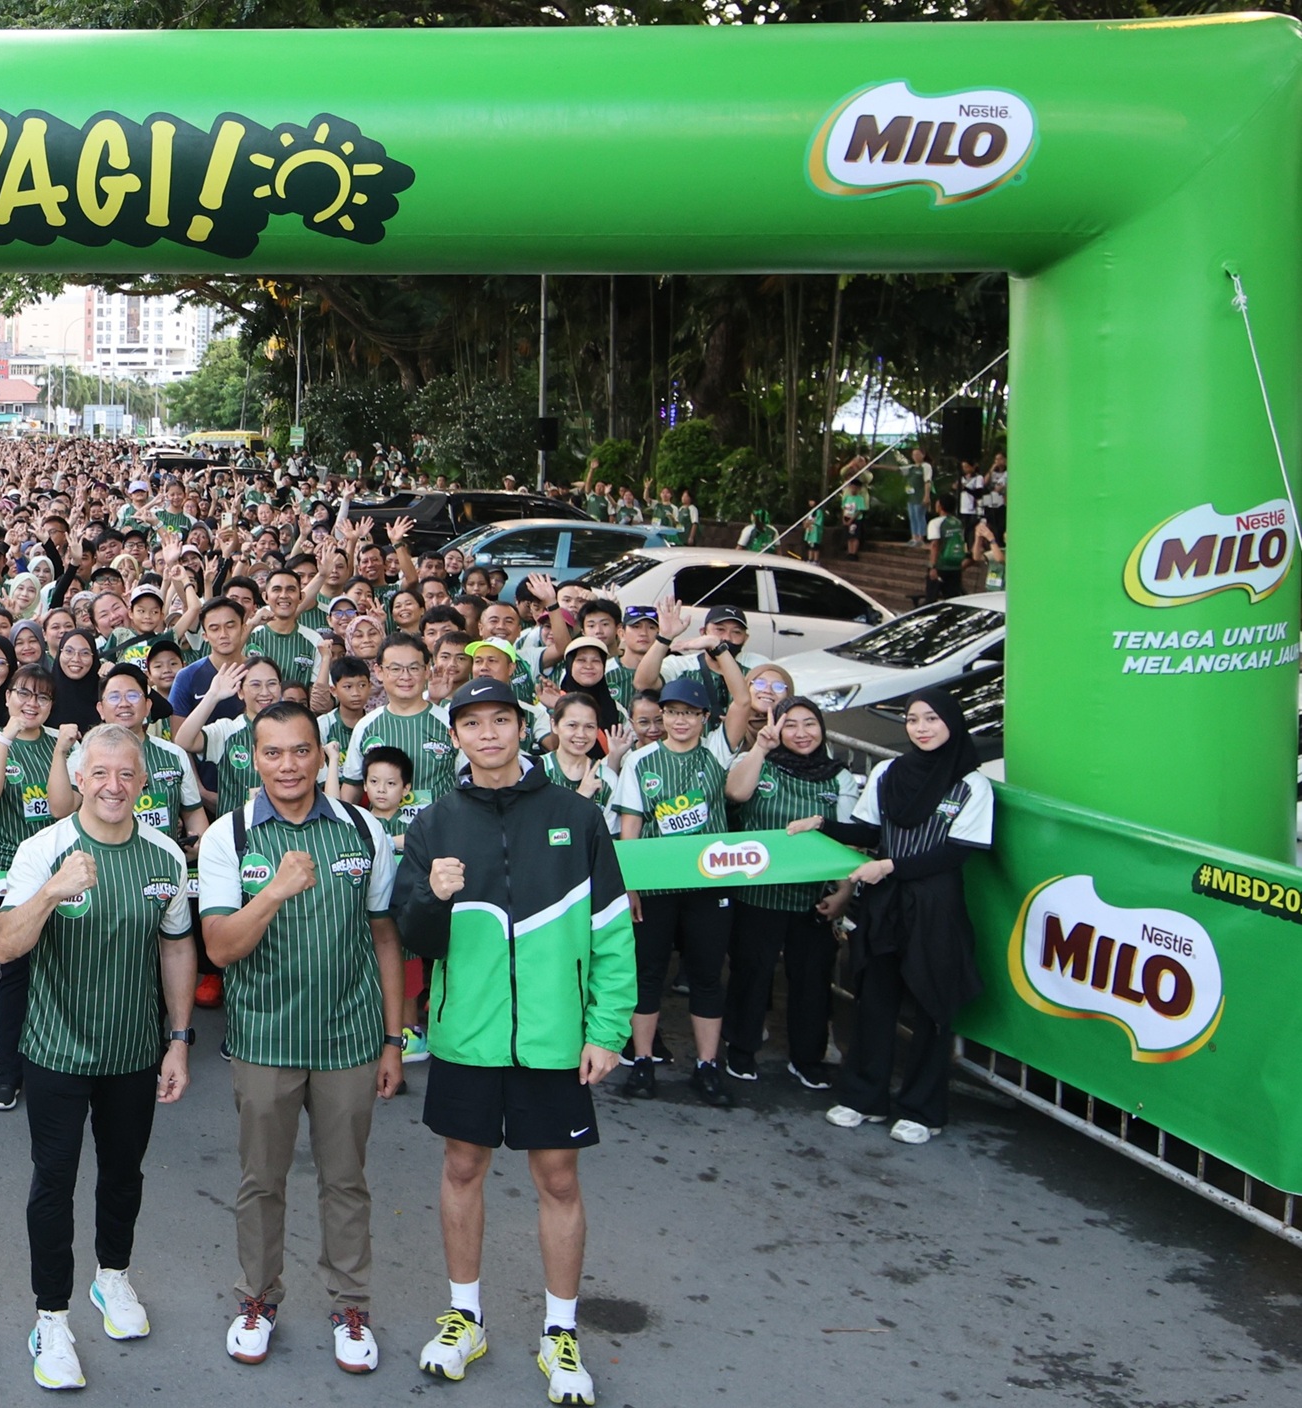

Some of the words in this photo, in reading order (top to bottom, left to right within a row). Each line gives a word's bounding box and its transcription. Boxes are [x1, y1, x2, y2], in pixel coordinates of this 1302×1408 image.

[843, 113, 1008, 168] MILO
[1154, 528, 1288, 581] MILO
[1112, 629, 1215, 650] TENAGA
[1222, 622, 1288, 646] UNTUK
[1122, 650, 1272, 675] MELANGKAH
[34, 800, 48, 814] 62
[654, 795, 689, 822] MILO
[668, 808, 704, 831] 8059E
[709, 851, 762, 868] MILO
[242, 870, 267, 879] MILO
[1198, 864, 1302, 914] #MBD20
[1040, 911, 1196, 1020] MILO
